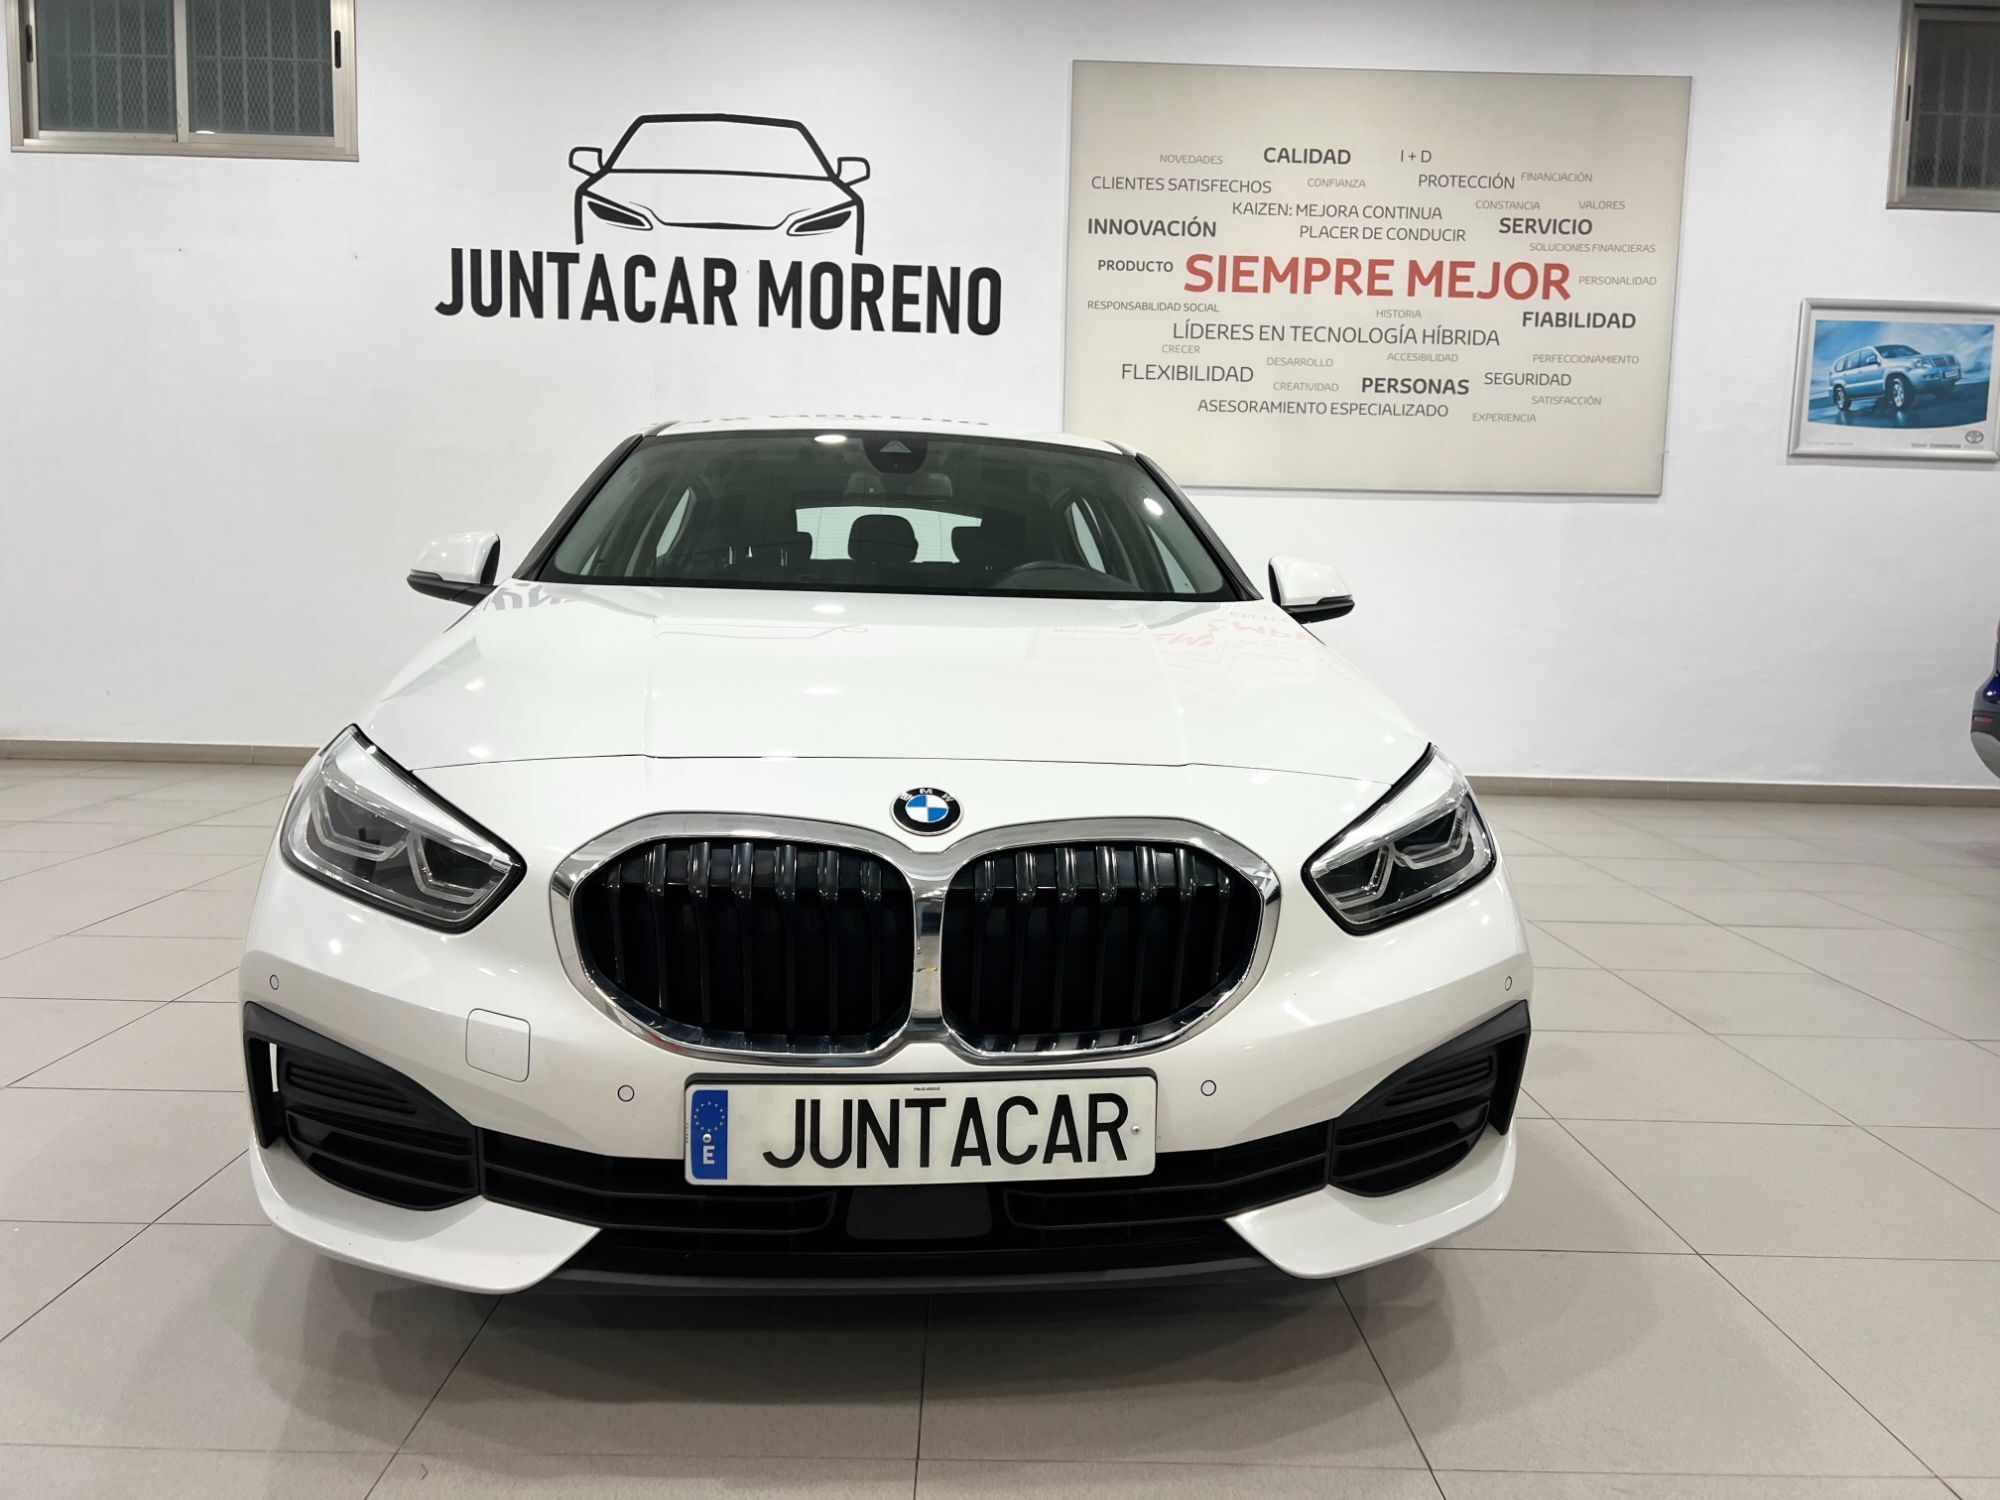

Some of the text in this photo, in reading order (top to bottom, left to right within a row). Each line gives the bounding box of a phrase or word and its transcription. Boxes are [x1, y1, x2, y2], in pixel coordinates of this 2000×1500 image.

[1160, 154, 1223, 165] NOVEDADES
[1264, 147, 1351, 164] CALIDAD
[1307, 178, 1366, 188] CONFIANZA
[1419, 172, 1515, 189] PROTECCIÓN
[1521, 171, 1592, 182] FINANCIACIÓN
[1092, 176, 1271, 193] CLIENTES SATISFECHOS
[1233, 202, 1442, 220] KAIZEN: MEJORA CONTINUA
[1475, 200, 1541, 210] CONSTANCIA
[1579, 200, 1625, 210] VALORES
[1088, 216, 1216, 237] INNOVACIÓN
[1300, 225, 1466, 241] PLACER DE CONDUCIR
[1499, 218, 1592, 235] SERVICIO
[1529, 243, 1656, 252] SOLUCIONES FINANCIERAS
[1098, 260, 1173, 272] PRODUCTO
[1184, 254, 1570, 300] SIEMPRE MEJOR
[1579, 276, 1657, 285] PERSONALIDAD
[434, 247, 1002, 336] JUNTACAR MORENO
[1088, 300, 1219, 312] RESPONSABILIDAD SOCIAL
[1376, 309, 1422, 318] HISTORIA
[1523, 312, 1636, 328] FIABILIDAD
[1173, 319, 1500, 346] LÍDERES EN TECNOLOGÍA HÍBRIDA
[1162, 344, 1200, 354] CRECER
[1267, 357, 1333, 367] DESARROLLO
[1387, 352, 1458, 362] ACCESIBILIDAD
[1533, 354, 1639, 364] PERFECCIONAMIENTO
[1122, 364, 1253, 382] FLEXIBILIDAD
[1484, 372, 1571, 386] SEGURIDAD
[1273, 382, 1339, 391] CREATIVIDAD
[1362, 378, 1469, 395] PERSONAS
[1531, 395, 1602, 406] SATISFACCIÓN
[1198, 400, 1448, 417] ASESORAMIENTO ESPECIALIZADO
[1472, 413, 1536, 422] EXPERIENCIA
[900, 788, 954, 802] BMW
[763, 1092, 1128, 1169] JUNTACAR
[703, 1145, 715, 1165] E
